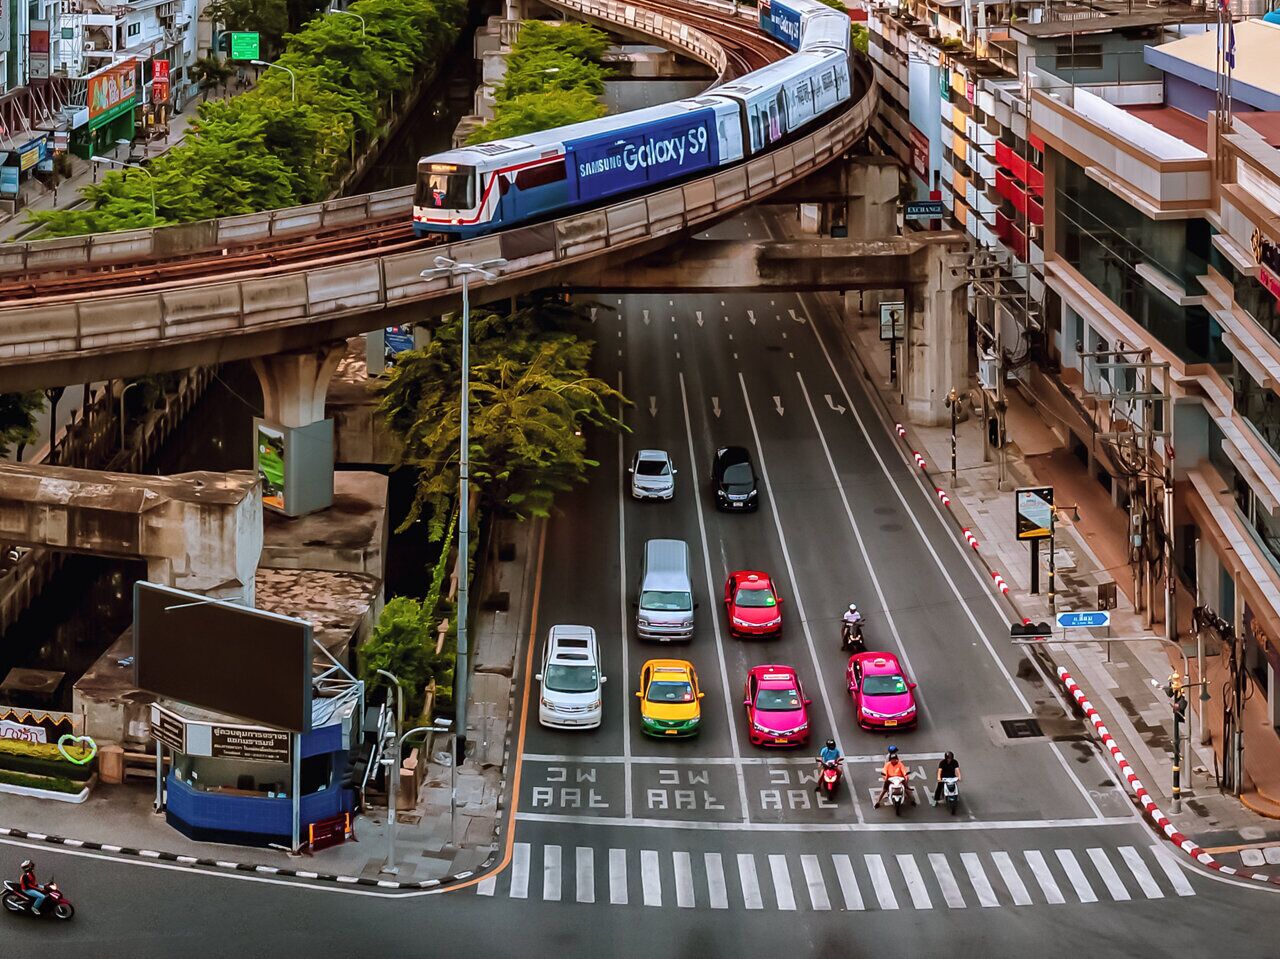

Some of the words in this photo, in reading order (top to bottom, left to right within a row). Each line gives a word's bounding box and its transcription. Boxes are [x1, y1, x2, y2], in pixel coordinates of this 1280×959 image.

[579, 155, 622, 177] SAMSUNG
[623, 135, 686, 171] Galaxy
[688, 126, 707, 154] S9
